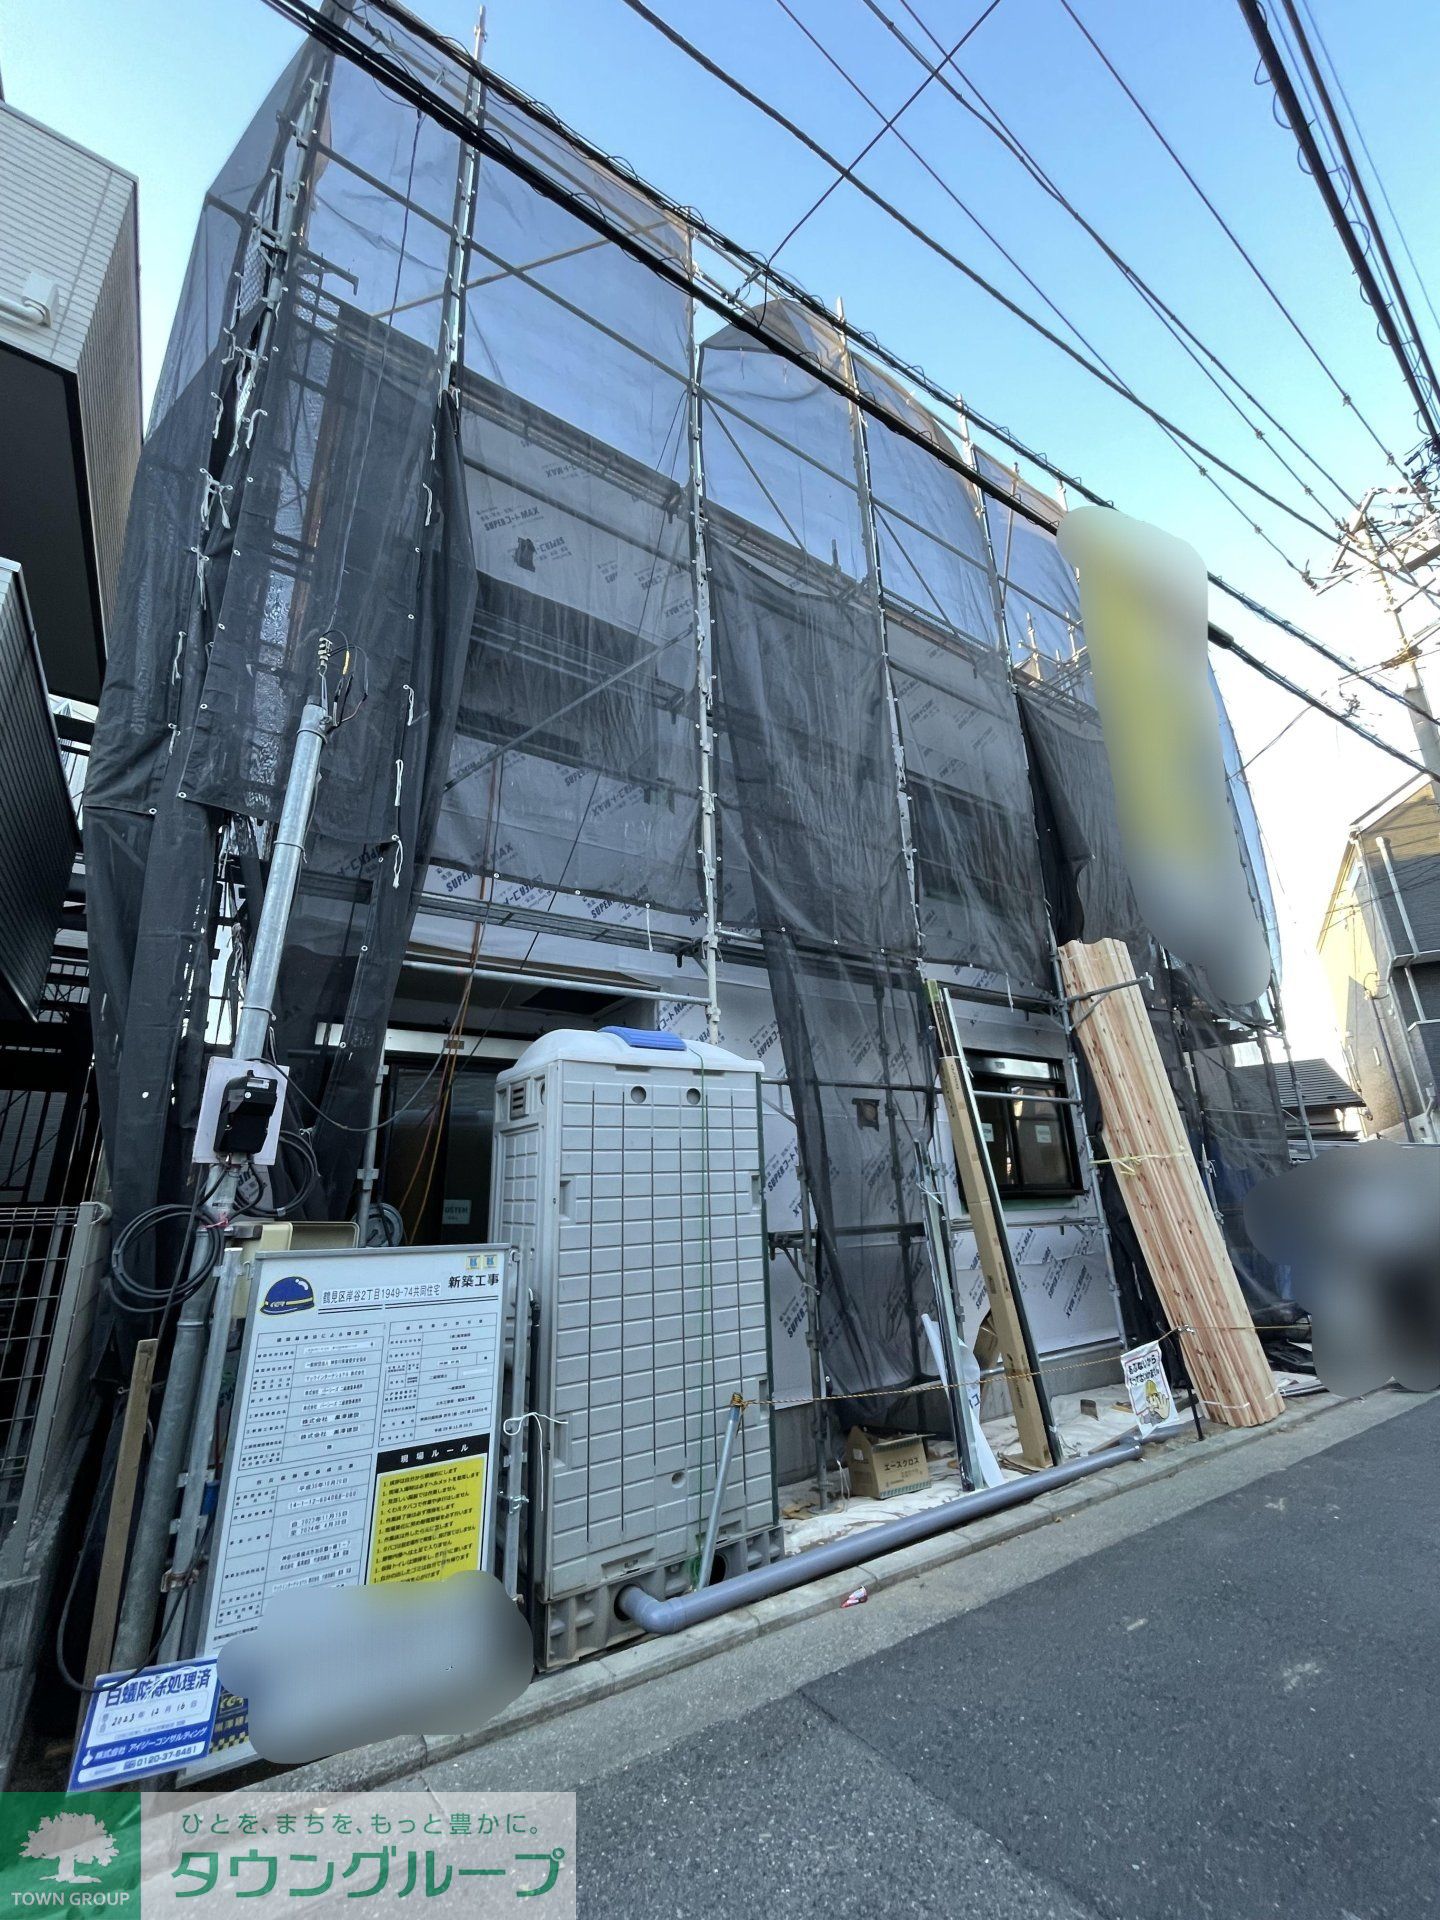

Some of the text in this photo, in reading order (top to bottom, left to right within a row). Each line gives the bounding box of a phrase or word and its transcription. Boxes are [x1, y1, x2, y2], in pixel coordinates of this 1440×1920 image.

[448, 1273, 499, 1288] 新築工事
[400, 1443, 468, 1463] 現場ルール
[884, 1457, 920, 1471] エースクロス
[104, 1668, 211, 1708] 白蟻防除処理済
